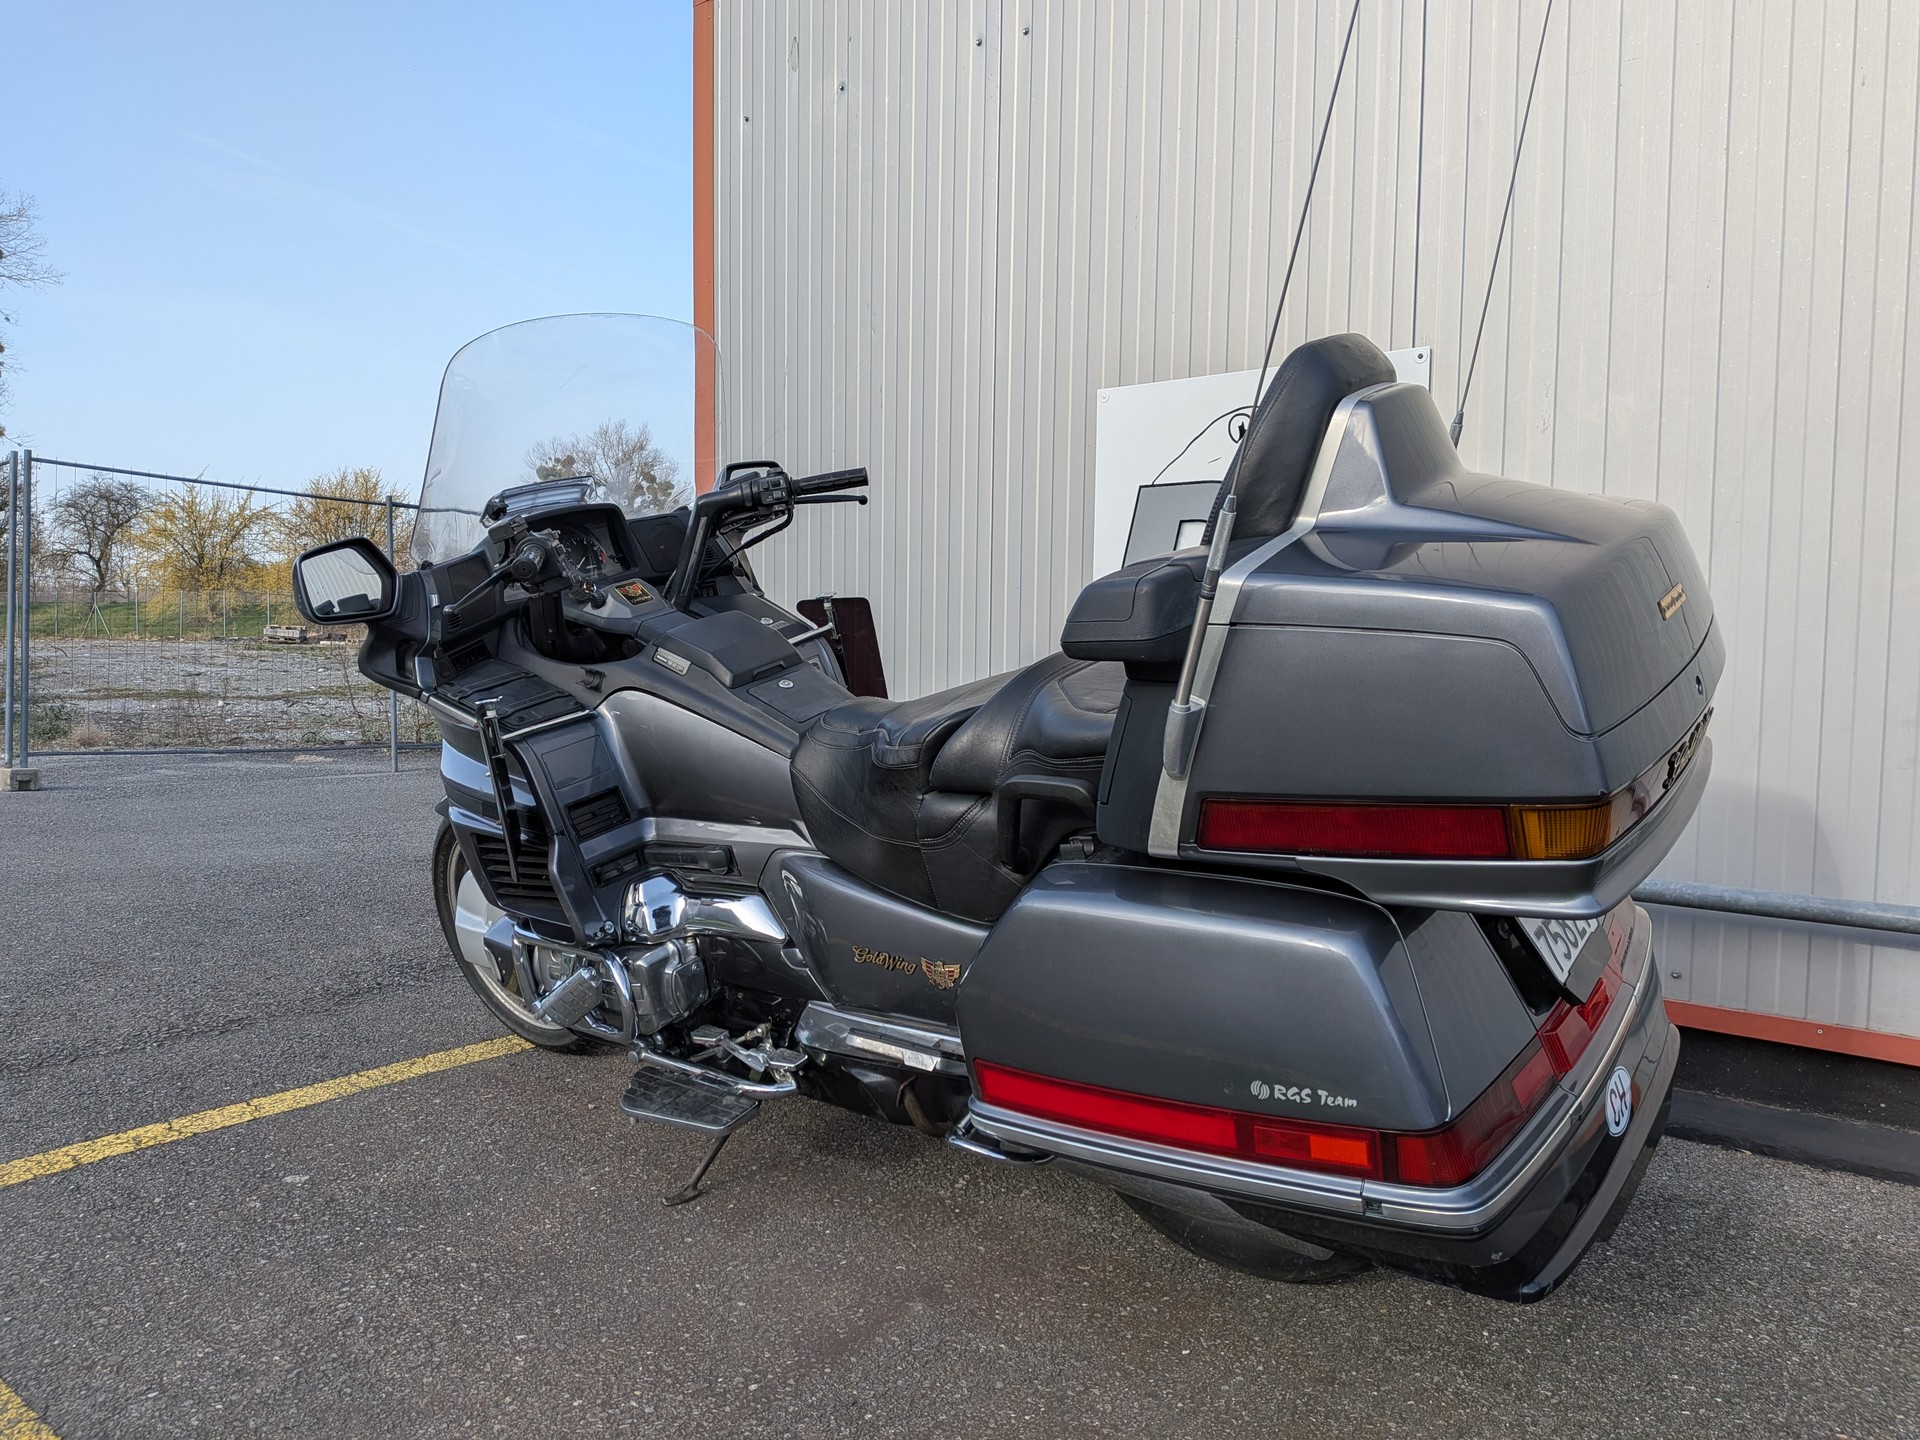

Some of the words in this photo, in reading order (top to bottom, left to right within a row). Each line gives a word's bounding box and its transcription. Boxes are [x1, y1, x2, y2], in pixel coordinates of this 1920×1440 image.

[1534, 919, 1591, 973] 758
[1273, 1084, 1312, 1104] RGS
[1317, 1089, 1358, 1108] Team
[1609, 1073, 1628, 1127] CH
